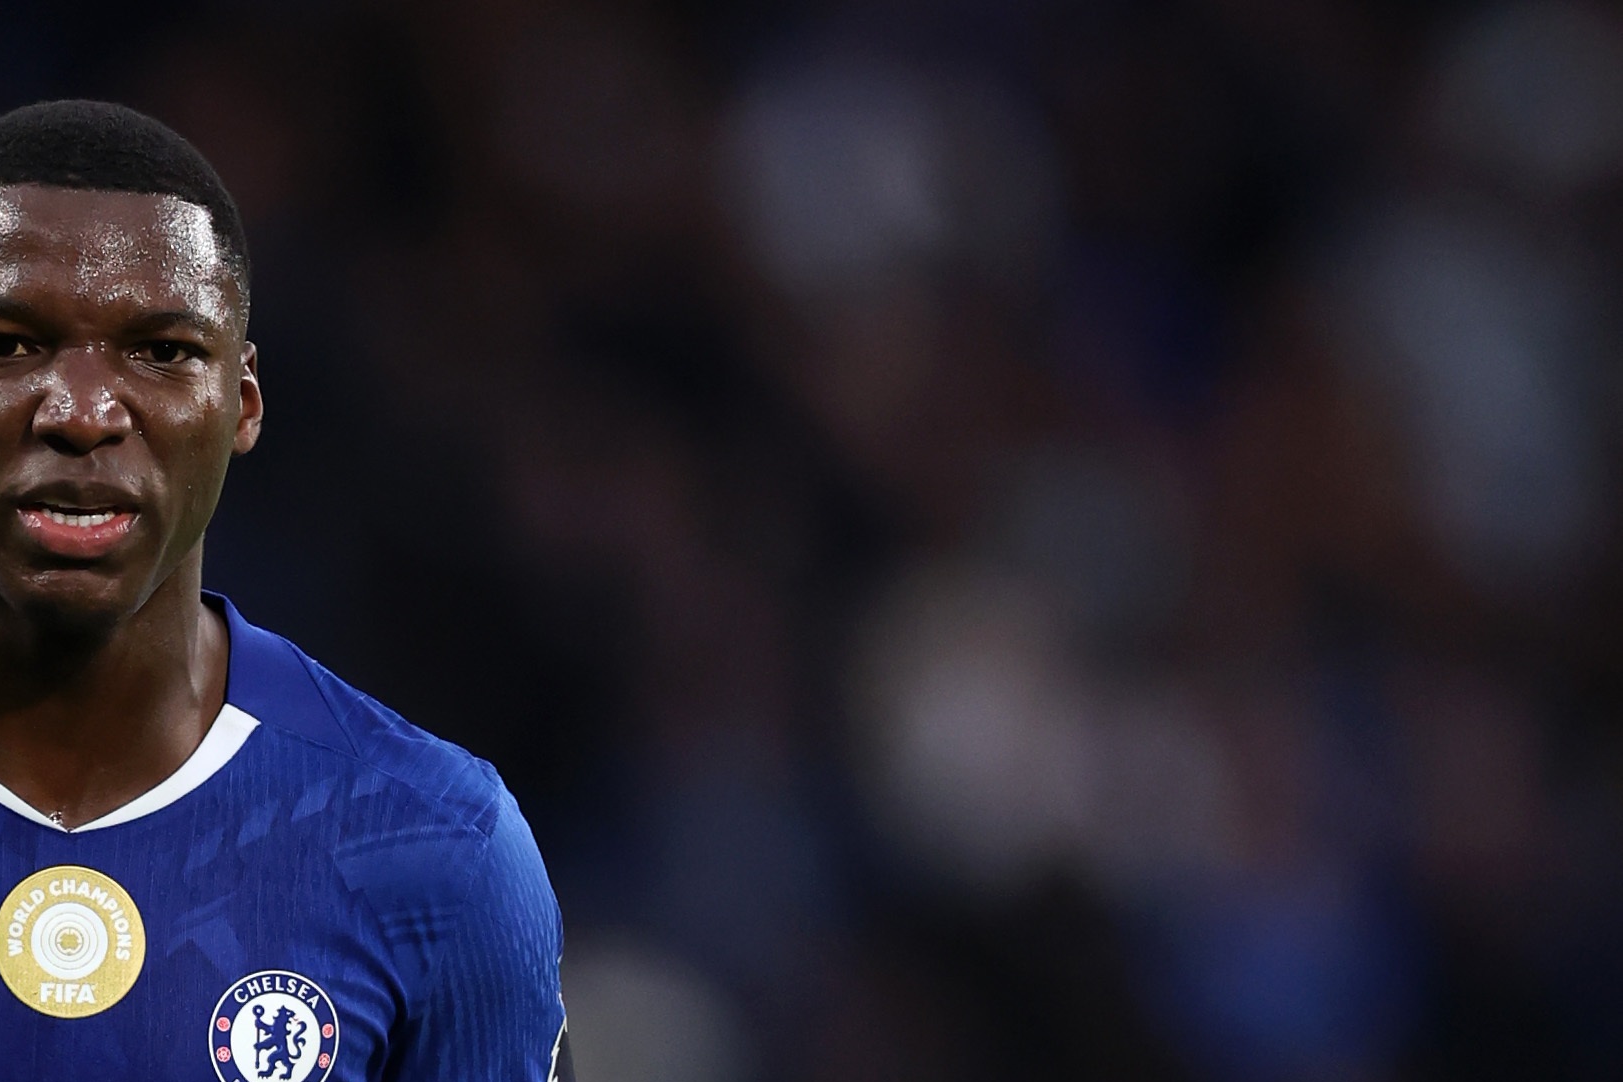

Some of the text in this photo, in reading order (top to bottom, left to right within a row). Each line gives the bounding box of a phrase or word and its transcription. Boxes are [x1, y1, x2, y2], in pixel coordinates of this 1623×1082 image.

[7, 878, 133, 961] WORLD CHAMPIONS
[40, 983, 95, 1003] FIFA
[234, 976, 320, 1009] CHELSEA
